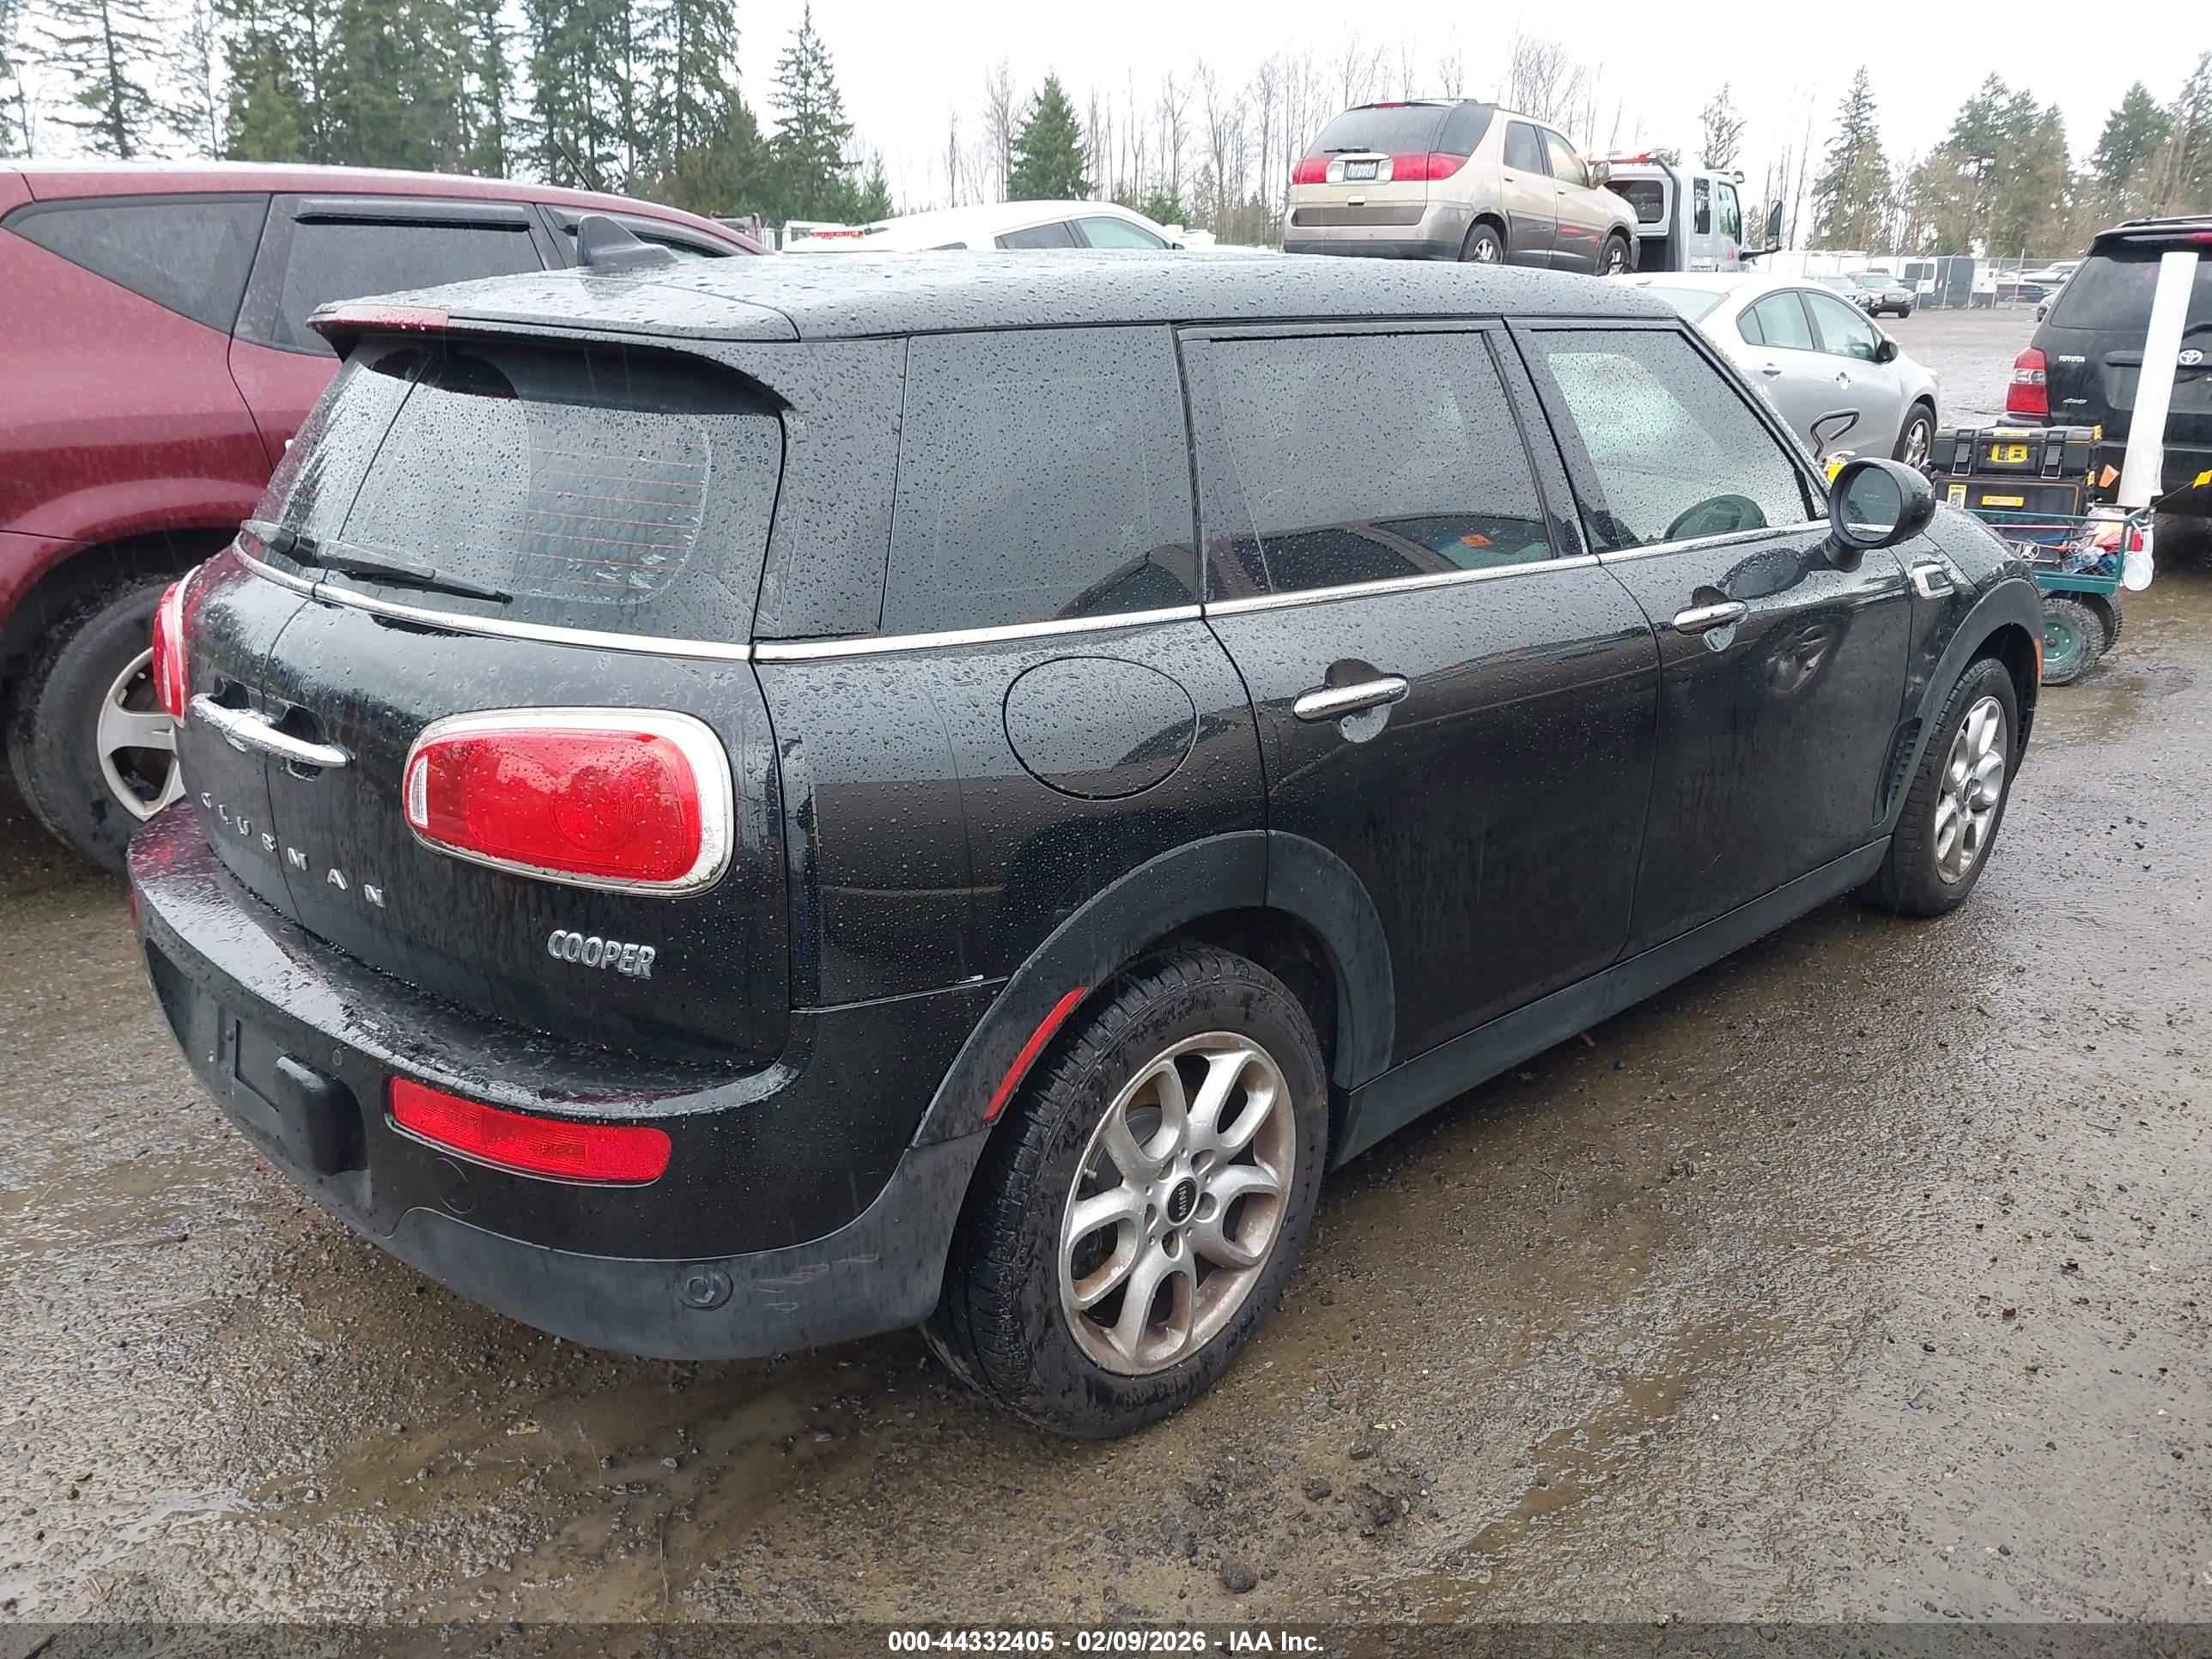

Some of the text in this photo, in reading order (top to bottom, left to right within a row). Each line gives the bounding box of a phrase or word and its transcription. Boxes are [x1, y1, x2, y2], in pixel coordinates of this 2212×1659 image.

[2058, 355, 2086, 363] TOYOTA
[201, 792, 386, 908] CLUBMAN
[547, 929, 656, 979] COOPER
[1178, 1185, 1187, 1218] MINI
